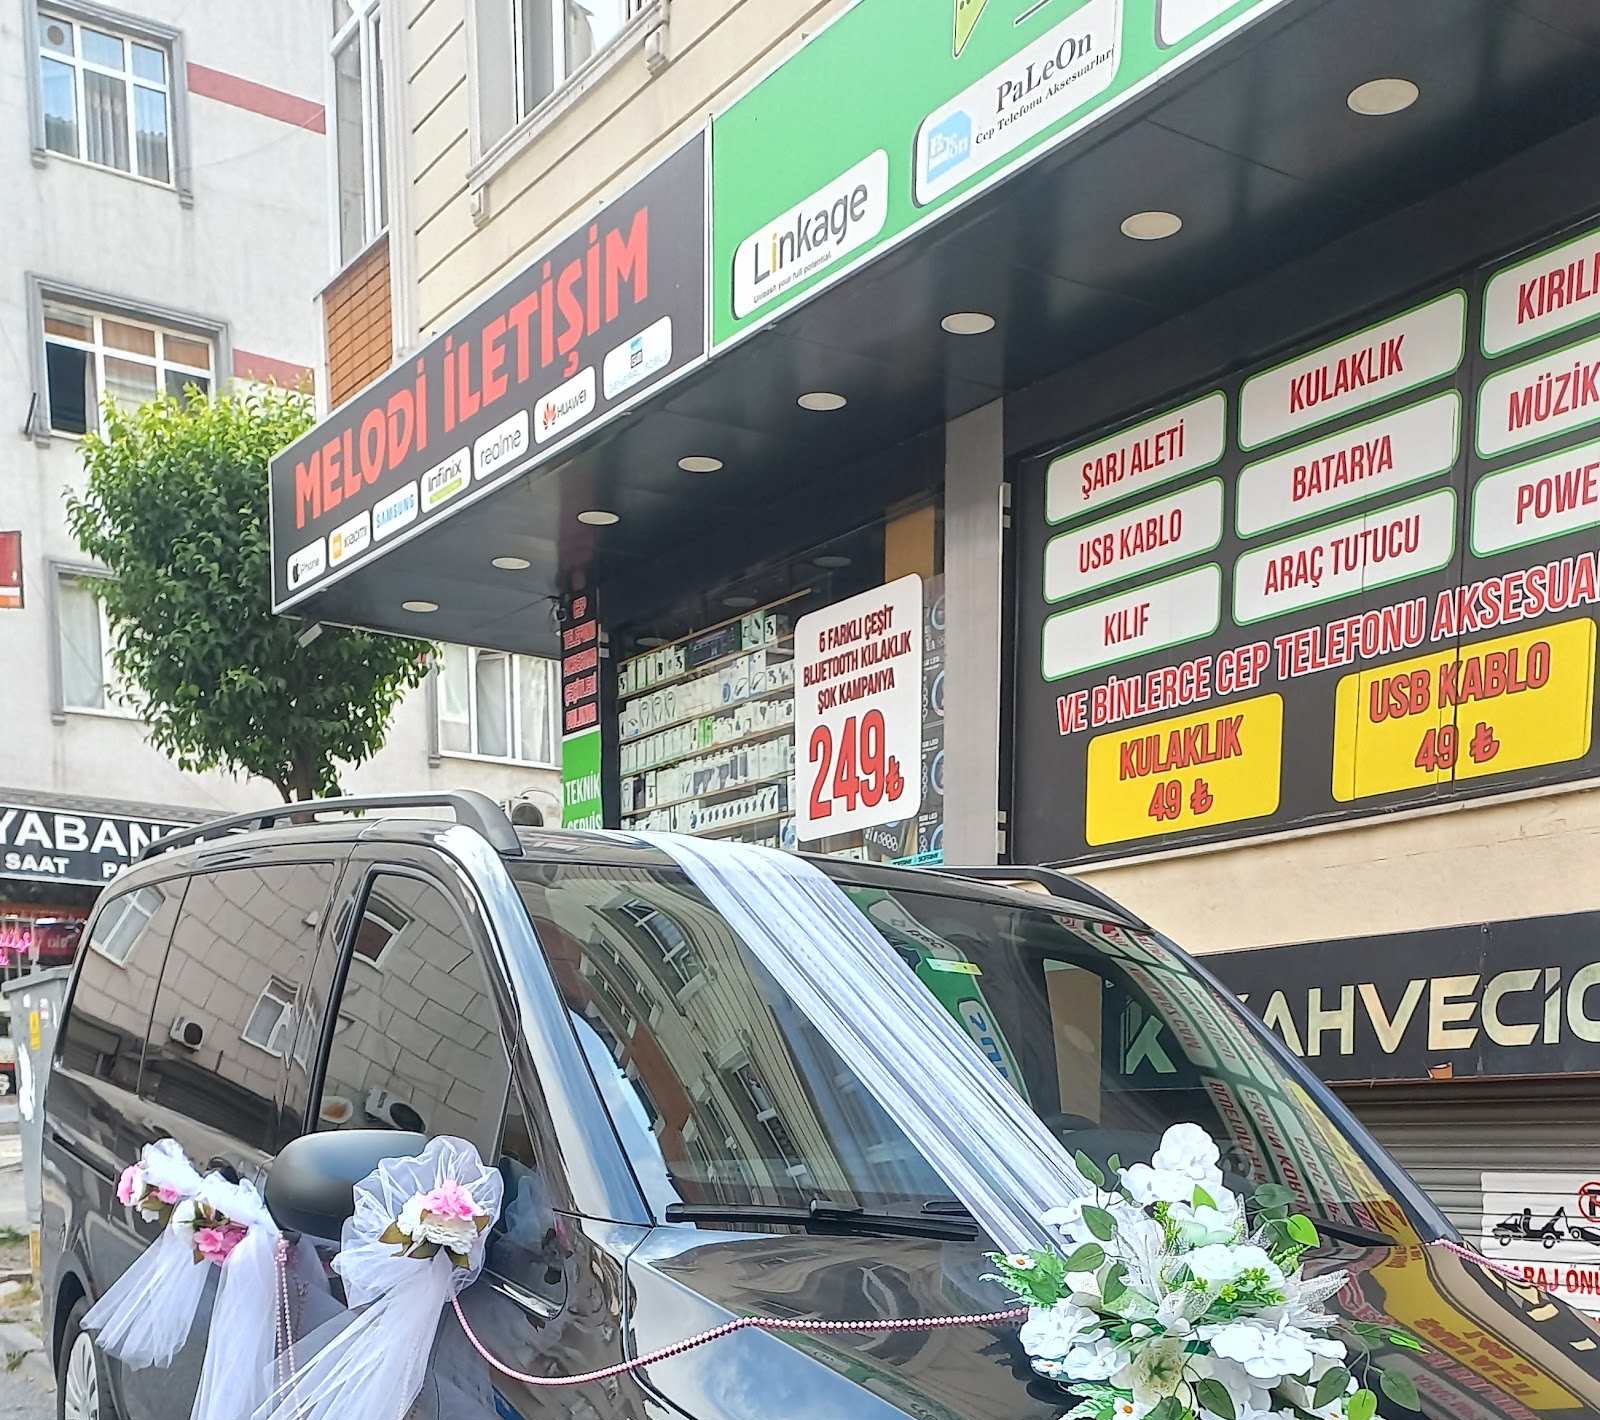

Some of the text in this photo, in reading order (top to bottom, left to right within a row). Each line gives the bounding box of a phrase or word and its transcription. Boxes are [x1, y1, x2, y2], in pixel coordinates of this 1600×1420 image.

[996, 33, 1092, 114] PaLeOn
[975, 127, 995, 144] Cep
[997, 97, 1043, 131] Telefonu
[754, 184, 868, 285] Linkage
[778, 276, 791, 290] your
[792, 265, 803, 280] full
[1517, 252, 1600, 325] KIRIL
[294, 206, 648, 529] MELODİ İLETİŞİM
[1290, 335, 1404, 413] KULAKLIK
[1509, 361, 1600, 431] MÜZİK
[557, 388, 586, 420] HUAWEI
[480, 429, 521, 467] realme
[1081, 419, 1185, 500] ŞARJ ALETİ
[1292, 435, 1394, 502] BATARYA
[376, 494, 414, 528] SAMSUNG
[1079, 509, 1183, 573] USB KABLO
[1264, 516, 1421, 596] ARAÇ TUTUCU
[828, 618, 862, 650] FARKLI
[865, 604, 893, 640] ÇEŞİT
[1104, 603, 1150, 647] KILIF
[804, 648, 858, 687] BLUETOOTH
[861, 630, 911, 670] KULAKLIK
[1057, 693, 1089, 734] VE
[1092, 655, 1212, 726] BİNLERCE
[1216, 644, 1270, 694] CEP
[1276, 610, 1426, 680] TELEFONU
[1370, 641, 1551, 723] USB KABLO
[818, 667, 894, 714] ŞOK KAMPANYA
[1119, 716, 1243, 780] KULAKLIK
[1415, 729, 1458, 772] 49
[565, 769, 600, 805] TEKNİK
[1149, 780, 1184, 820] 49
[0, 808, 204, 858] YABAN
[5, 852, 70, 874] SAAT
[1237, 962, 1600, 1057] AHVECİO
